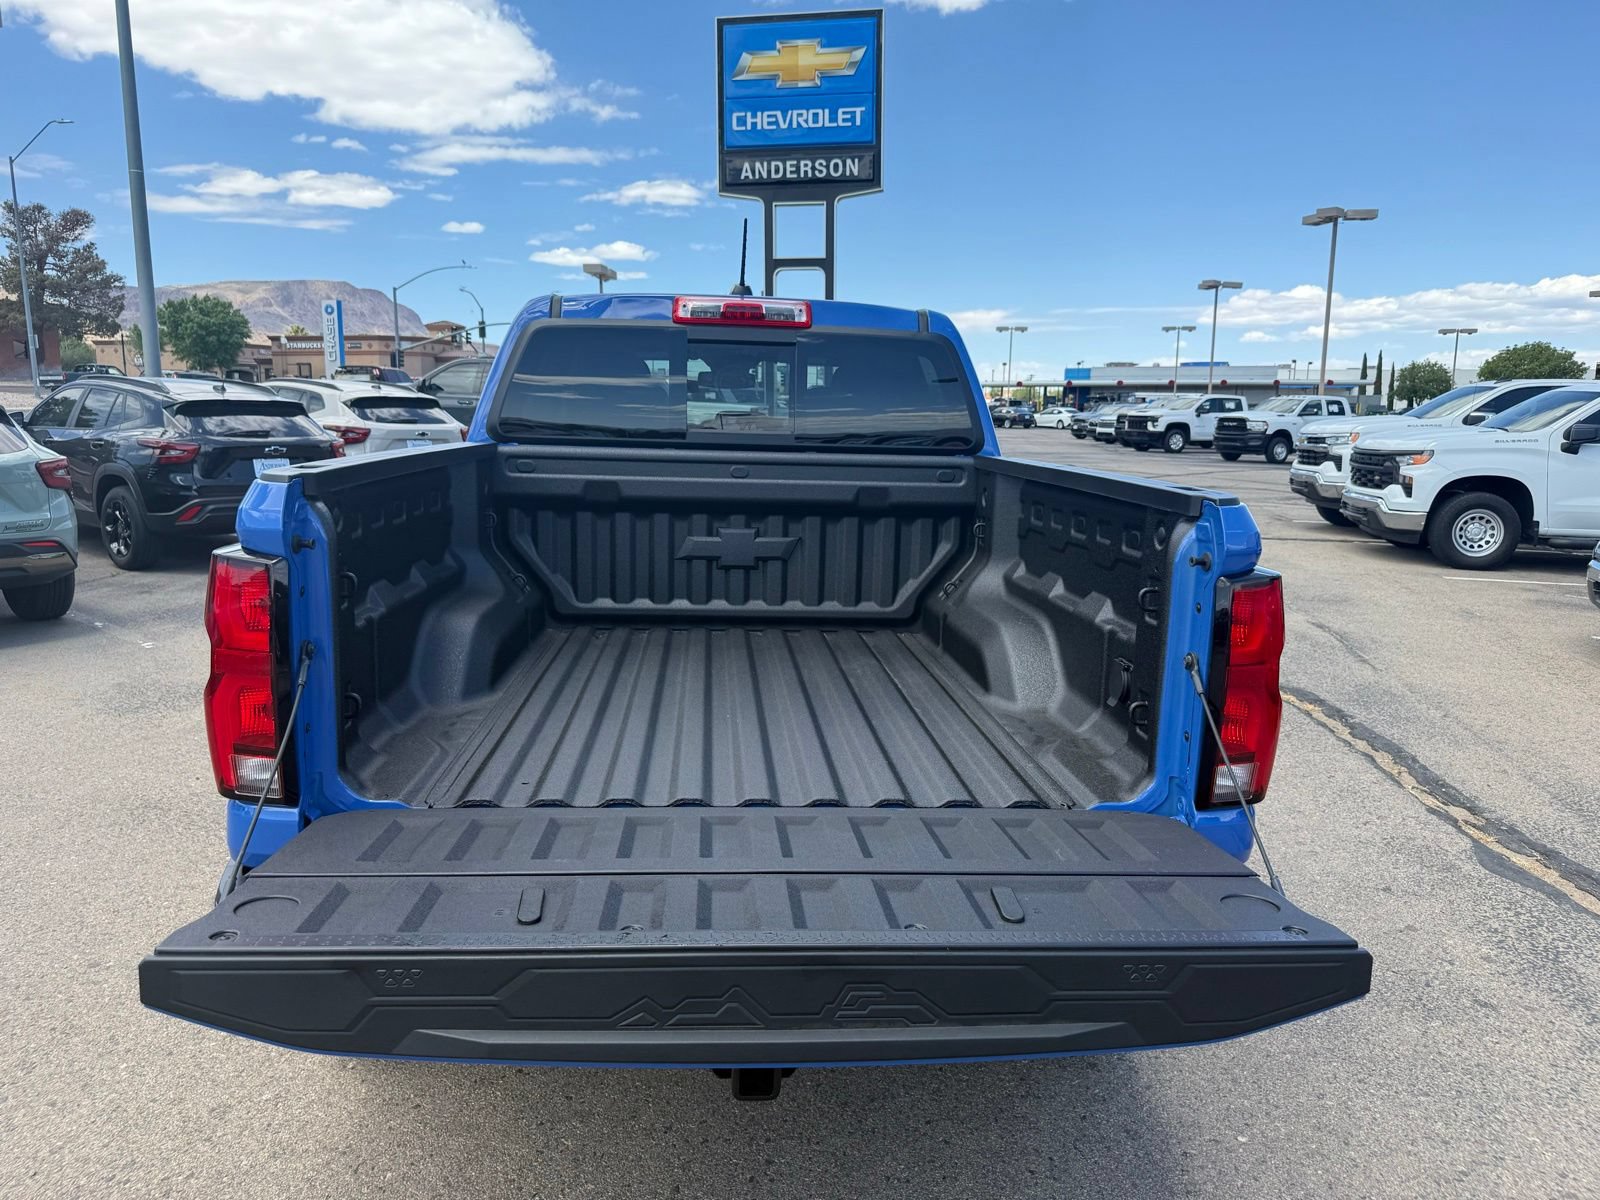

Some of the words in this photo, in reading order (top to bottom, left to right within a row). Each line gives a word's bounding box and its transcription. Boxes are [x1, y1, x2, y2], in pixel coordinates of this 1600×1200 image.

[731, 107, 866, 131] CHEVROLET
[740, 158, 860, 180] ANDERSON
[326, 316, 337, 361] CHASE
